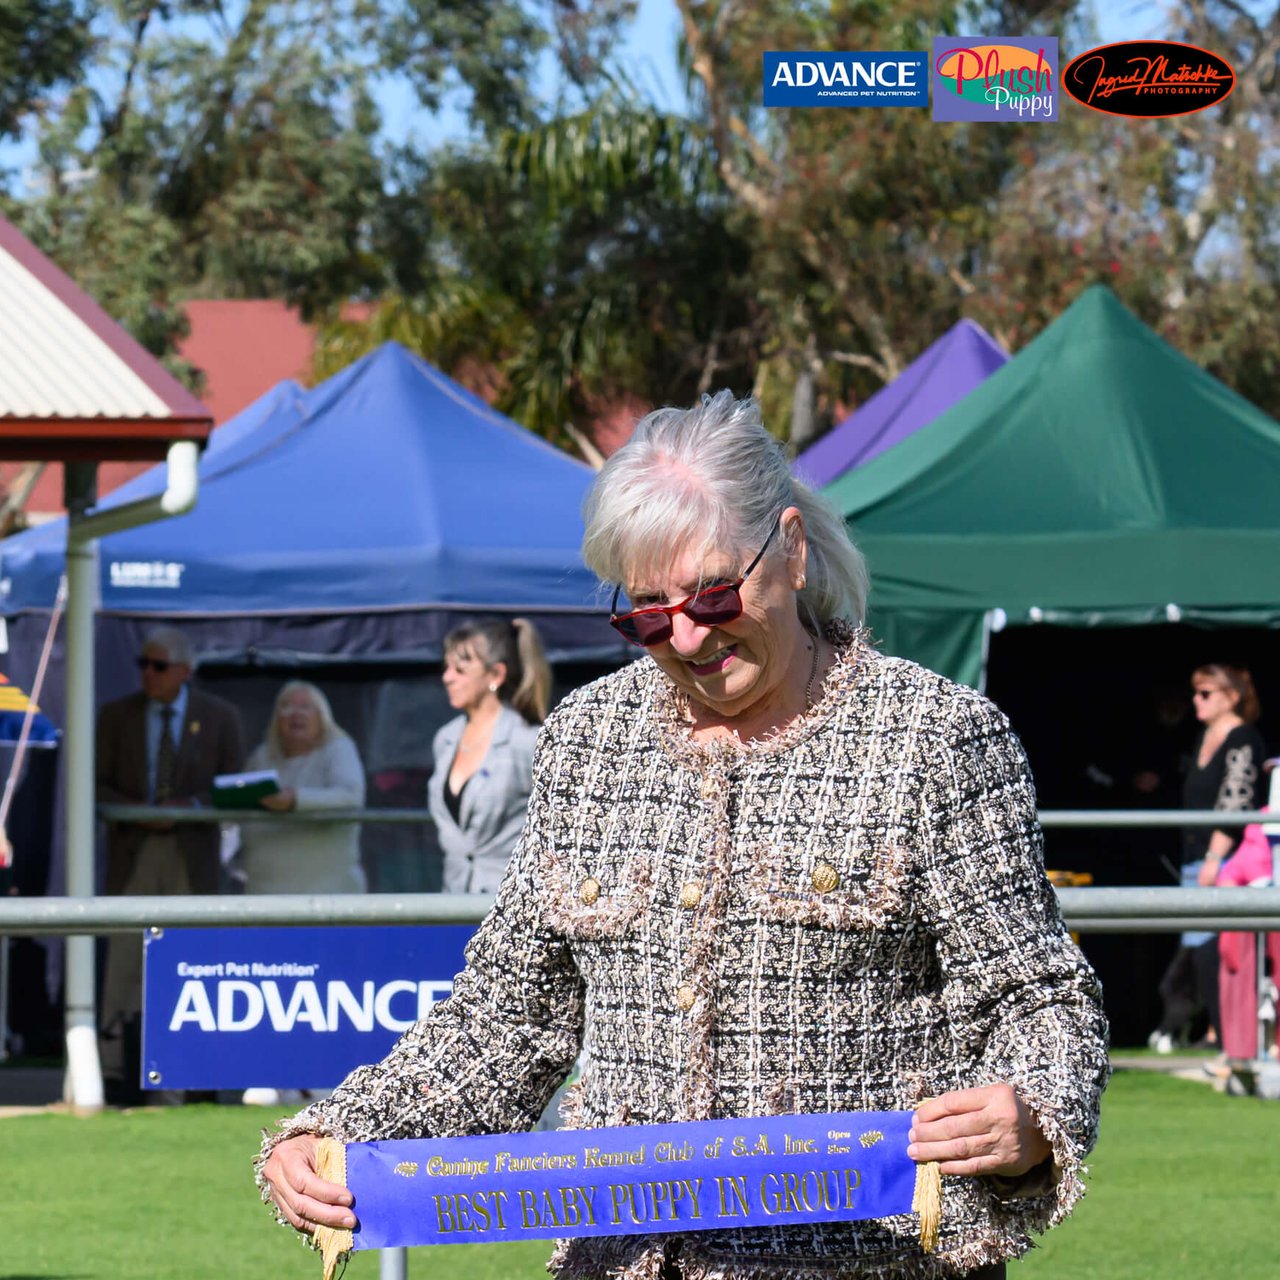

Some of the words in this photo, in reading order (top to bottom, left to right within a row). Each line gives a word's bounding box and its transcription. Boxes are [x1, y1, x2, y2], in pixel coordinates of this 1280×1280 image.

[177, 962, 224, 979] Expert
[225, 962, 250, 977] Pet
[251, 962, 315, 977] Nutrition
[426, 1155, 489, 1179] Canine
[494, 1151, 578, 1173] Fanciers
[582, 1145, 646, 1169] Kennel
[654, 1140, 695, 1163] Club
[703, 1136, 723, 1159] of
[783, 1133, 819, 1155] Inc.
[432, 1187, 509, 1234] BEST
[517, 1185, 598, 1229] BABY
[608, 1177, 704, 1225] PUPPY
[714, 1175, 751, 1217] IN
[760, 1168, 862, 1215] GROUP
